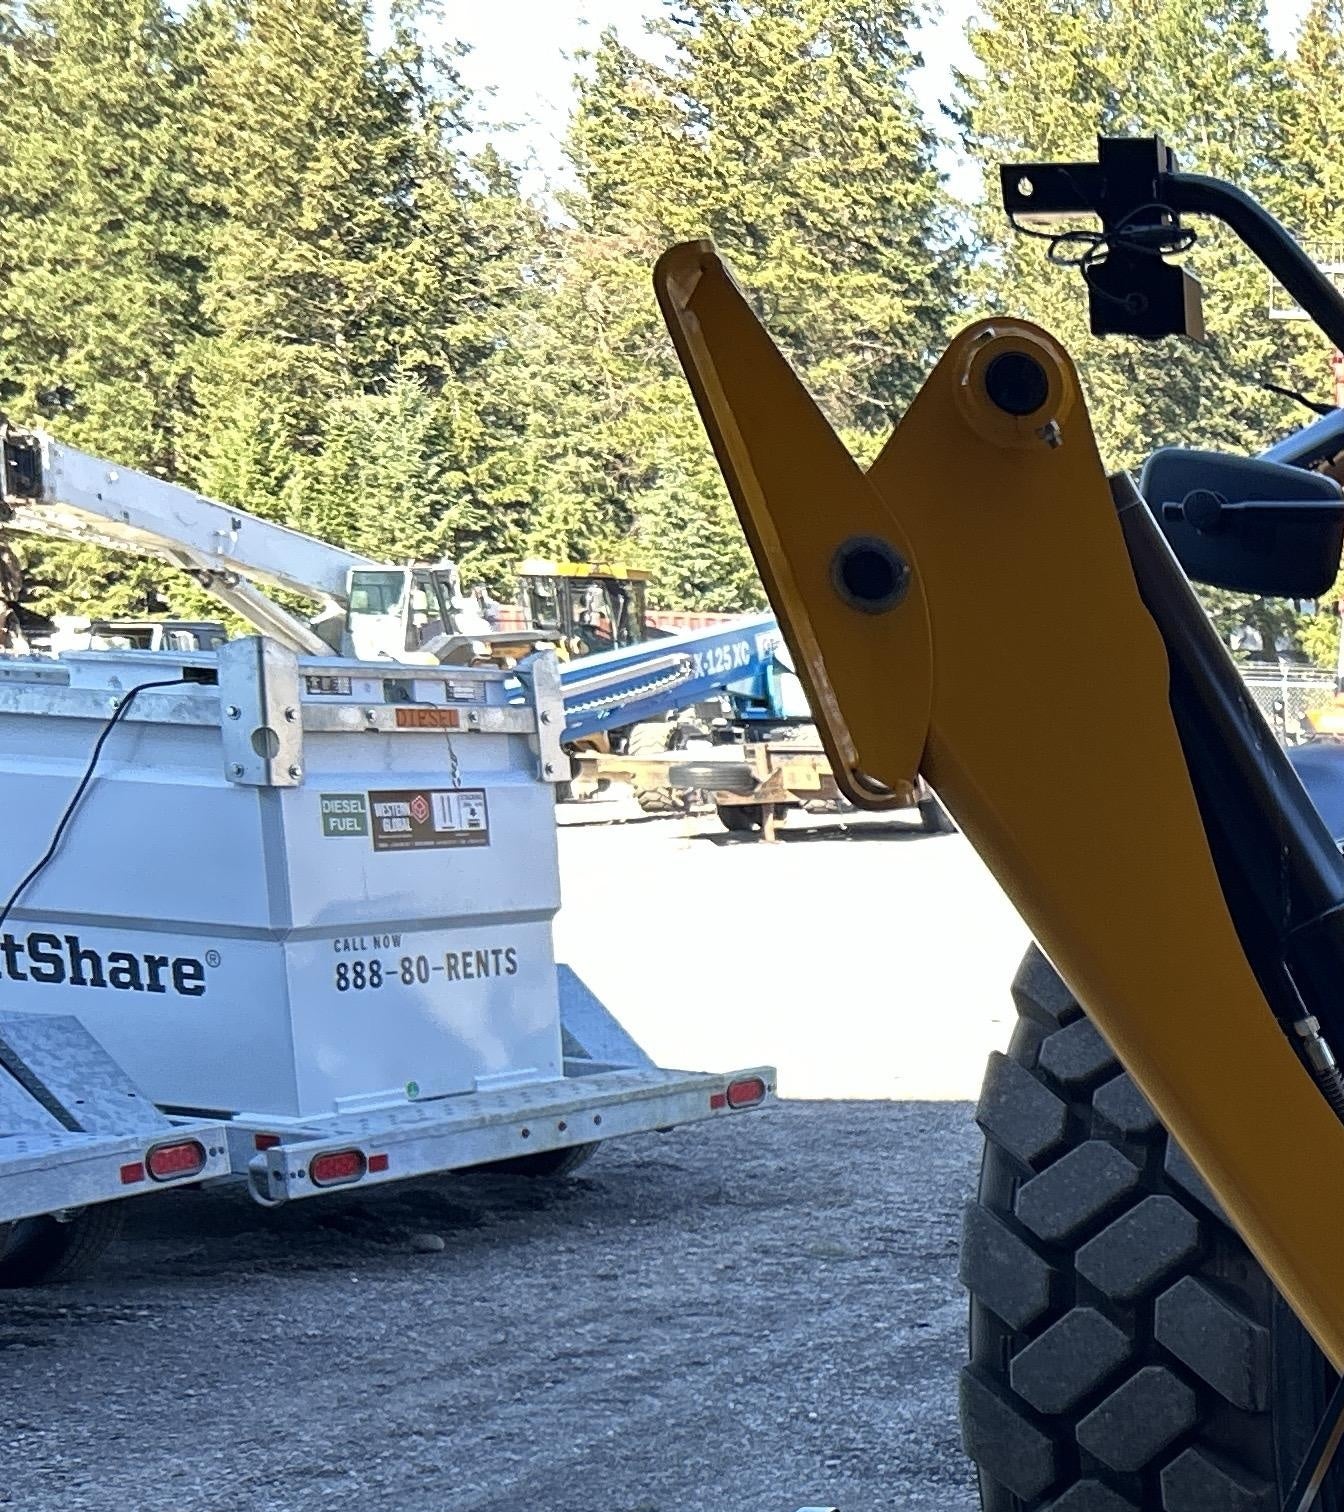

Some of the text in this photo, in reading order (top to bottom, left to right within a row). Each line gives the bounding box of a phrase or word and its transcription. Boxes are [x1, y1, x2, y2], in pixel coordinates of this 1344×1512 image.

[322, 800, 366, 814] DIESEL
[328, 817, 362, 831] FUEL
[334, 934, 402, 953] CALL NOW
[335, 947, 518, 992] 888-80-RENTS
